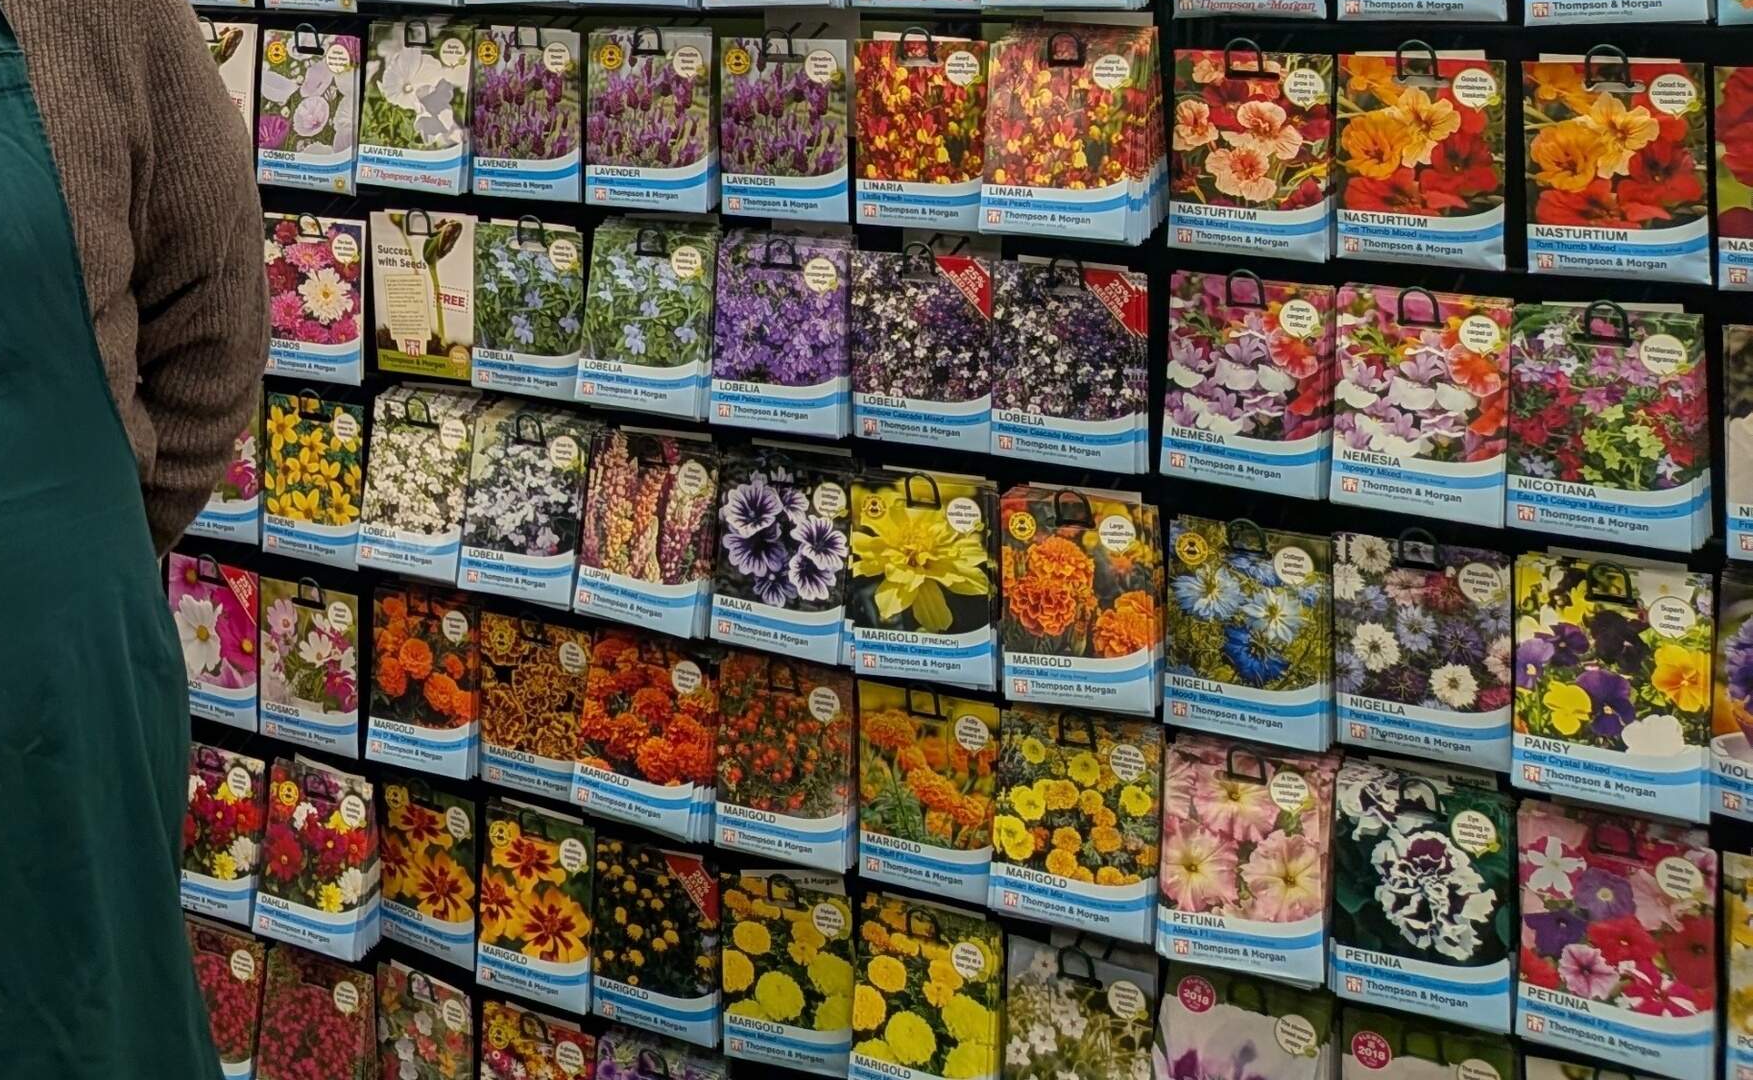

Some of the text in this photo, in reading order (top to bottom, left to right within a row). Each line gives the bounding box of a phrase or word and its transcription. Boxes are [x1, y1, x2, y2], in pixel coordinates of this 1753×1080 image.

[1552, 0, 1663, 12] Thompson & Morgan
[727, 175, 776, 186] LAVENDER
[863, 182, 904, 192] LINARIA
[1178, 204, 1257, 221] NASTURTIUM
[1343, 212, 1428, 228] NASTURTIUM
[1536, 227, 1628, 241] NASTURTIUM
[377, 245, 412, 256] Success
[378, 258, 427, 270] with Seeds
[960, 272, 979, 293] EXTRA
[965, 266, 985, 288] 25%
[437, 293, 466, 308] FREE
[863, 396, 907, 408] LOBELIA
[1171, 427, 1225, 445] NEMESIA
[1342, 450, 1401, 468] NEMESIA
[1518, 479, 1596, 498] NICOTIANA
[1517, 492, 1534, 502] Eau
[1536, 493, 1550, 503] De
[1589, 501, 1616, 512] Mixed
[1617, 504, 1629, 514] F1
[1540, 509, 1649, 533] Thompson & Morgan
[584, 568, 610, 580] LUPIN
[720, 597, 753, 612] MALVA
[862, 630, 959, 647] MARIGOLD (FRENCH)
[1013, 655, 1072, 668] MARIGOLD
[1172, 676, 1223, 694] NIGELLA
[1350, 696, 1405, 715] NIGELLA
[1524, 737, 1570, 755] PANSY
[580, 766, 629, 787] MARIGOLD
[1006, 867, 1067, 889] MARIGOLD
[262, 897, 290, 911] DAHLIA
[1173, 912, 1225, 929] PETUNIA
[1345, 949, 1402, 969] PETUNIA
[1528, 987, 1590, 1012] PETUNIA
